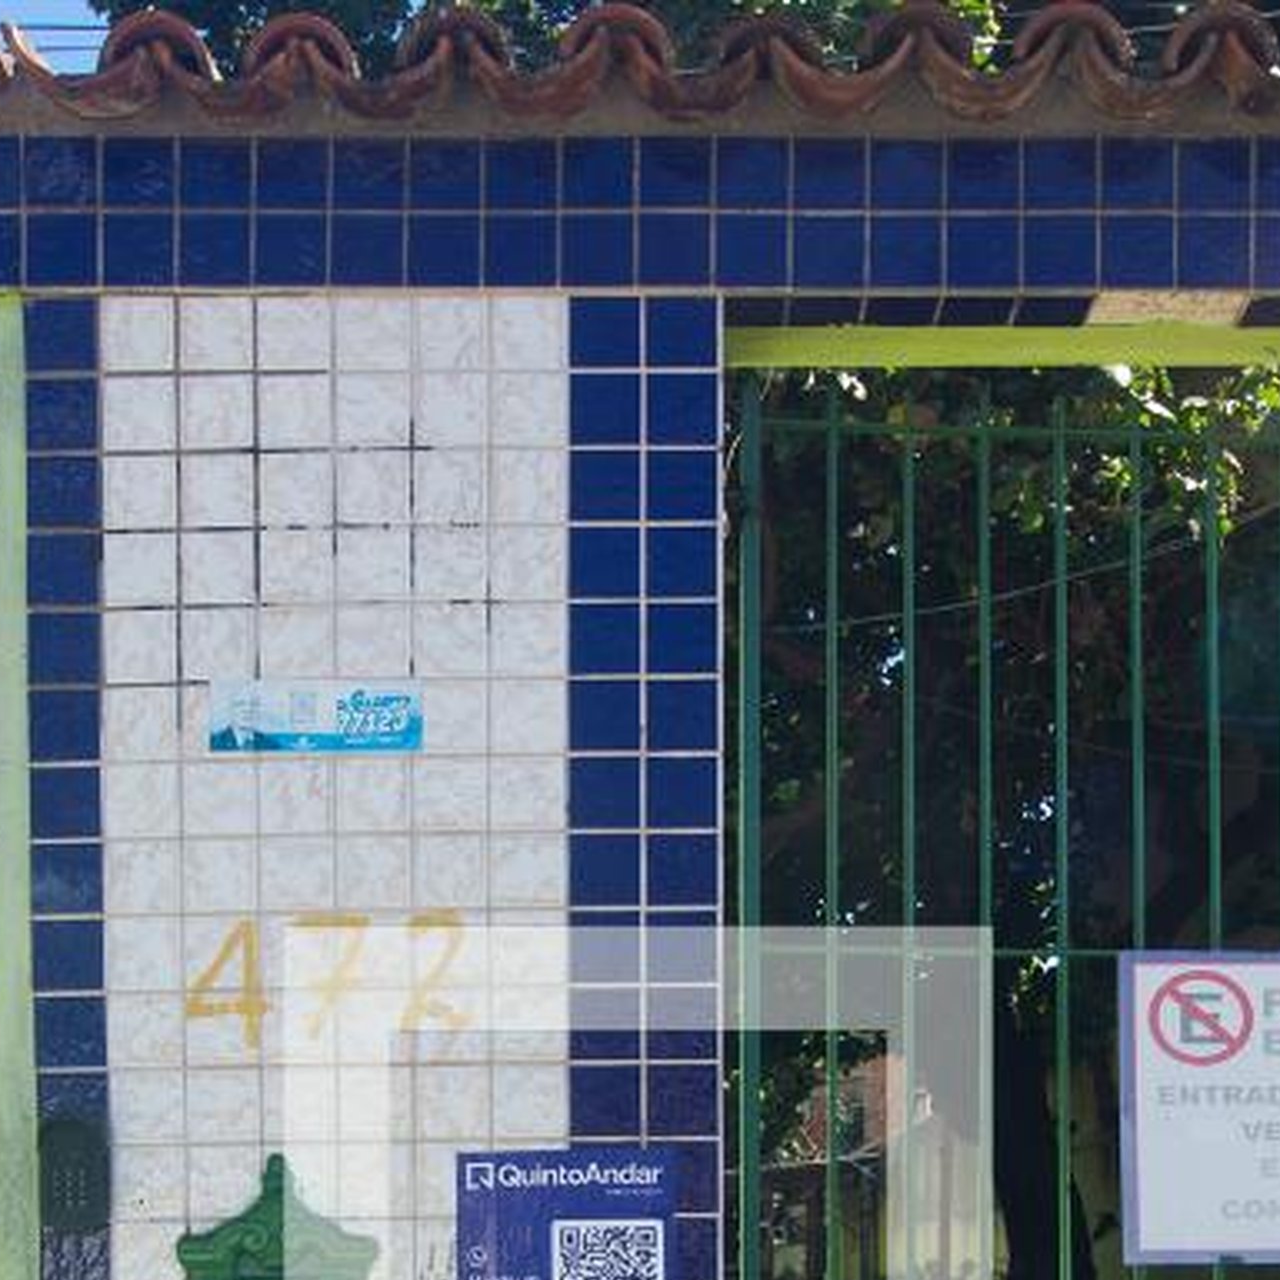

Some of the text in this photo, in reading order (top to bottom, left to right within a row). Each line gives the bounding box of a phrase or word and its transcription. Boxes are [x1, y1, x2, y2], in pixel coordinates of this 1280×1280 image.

[185, 908, 475, 1050] 472
[498, 1162, 662, 1188] QuintoAndar
[1259, 1157, 1280, 1179] E
